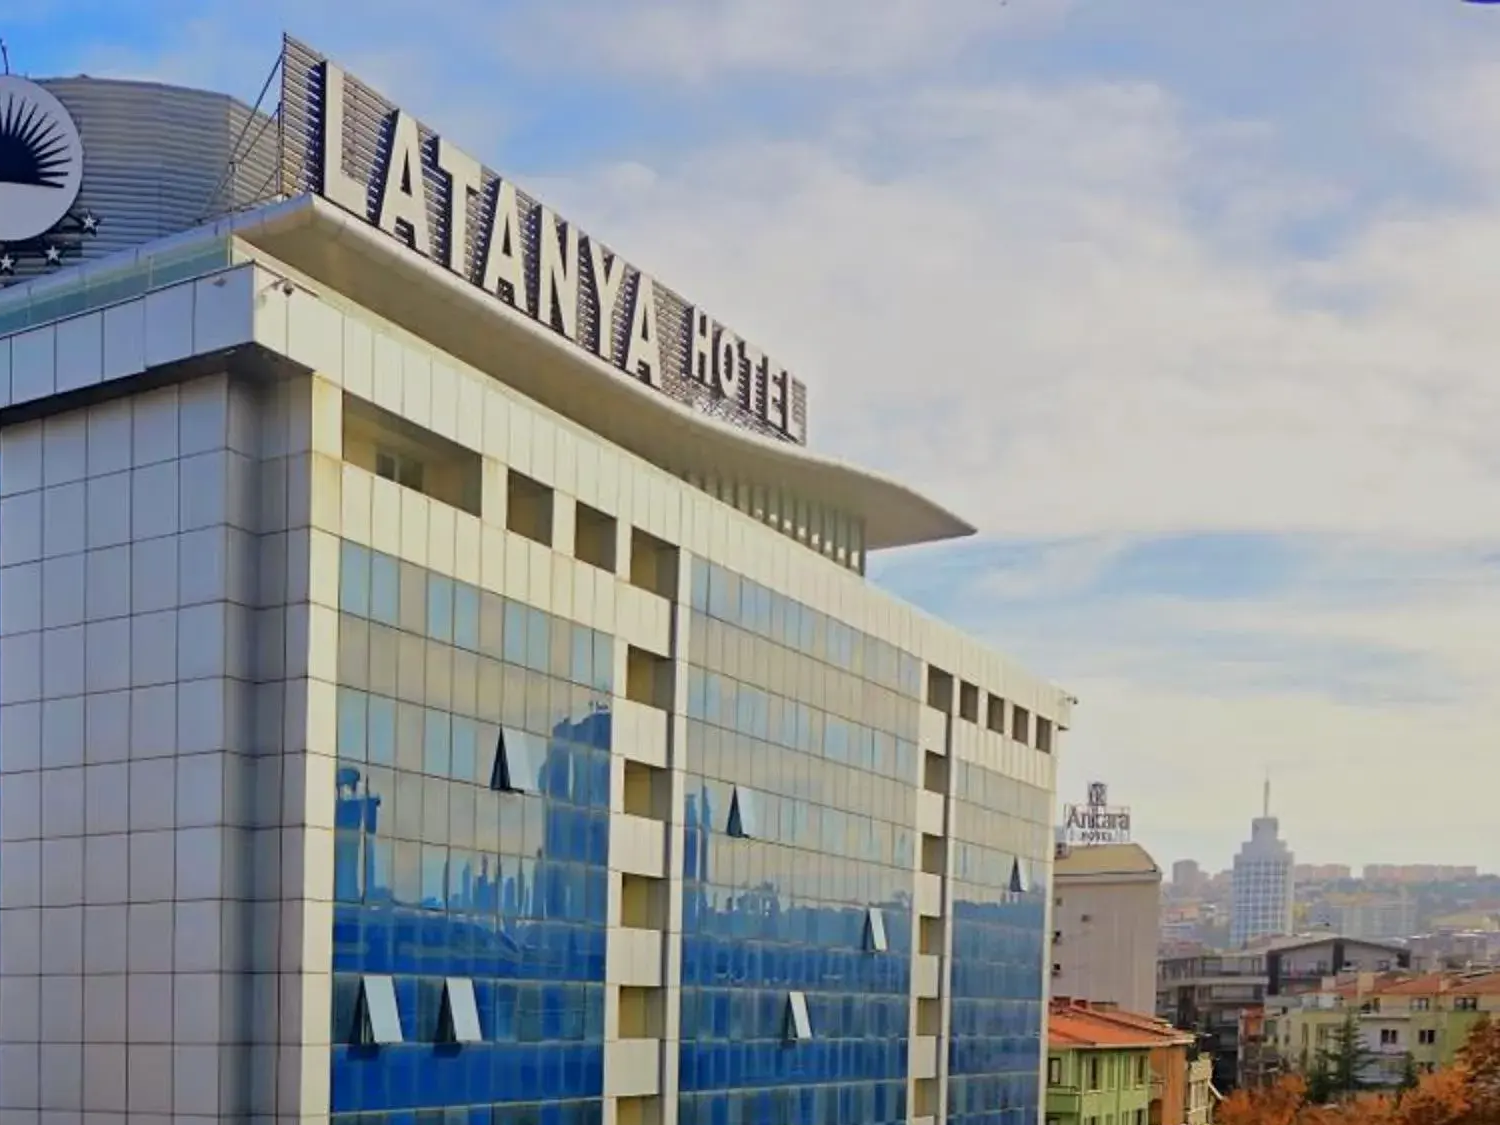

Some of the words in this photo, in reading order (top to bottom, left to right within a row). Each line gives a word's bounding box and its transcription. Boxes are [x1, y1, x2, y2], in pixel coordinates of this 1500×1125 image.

[322, 58, 663, 390] LATANYA
[691, 305, 801, 441] HOTEL
[1067, 806, 1130, 830] Ankara
